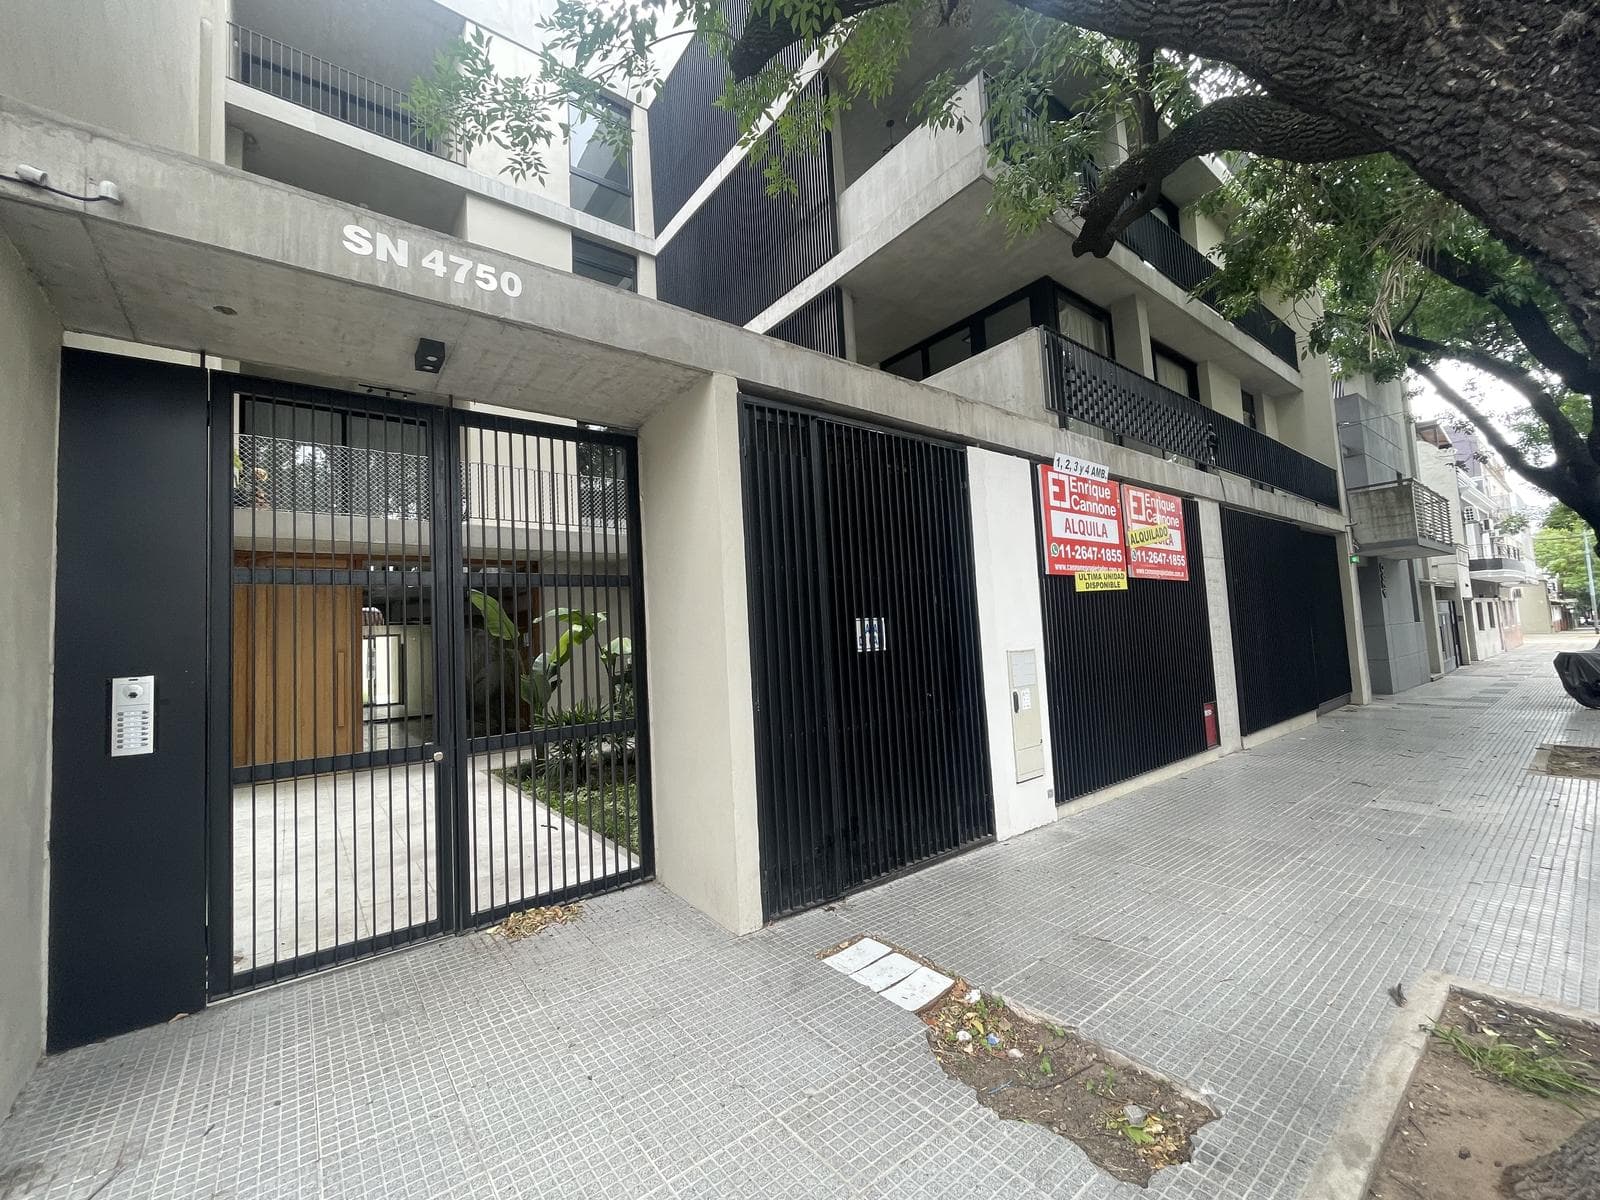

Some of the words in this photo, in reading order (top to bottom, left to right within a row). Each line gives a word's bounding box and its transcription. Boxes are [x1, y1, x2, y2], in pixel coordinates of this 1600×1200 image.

[342, 224, 409, 268] SN
[421, 249, 523, 298] 4750
[1056, 456, 1063, 471] 1,
[1065, 459, 1072, 472] 2,
[1073, 461, 1079, 472] 3
[1079, 465, 1085, 476] y
[1084, 464, 1091, 475] 4
[1091, 466, 1107, 480] AMB.
[1070, 476, 1111, 500] Enrique
[1071, 494, 1117, 517] Cannone
[1144, 493, 1176, 514] Enrique
[1064, 517, 1109, 539] ALQUILA
[1146, 509, 1180, 528] Cannone
[1130, 526, 1168, 545] ALQUILADO
[1059, 544, 1123, 563] 11-2647-1855
[1137, 549, 1186, 567] 11-2647-1855
[1078, 573, 1102, 581] ULTIMA
[1103, 572, 1125, 581] UNIDAD
[1085, 581, 1121, 590] DISPONIBLE
